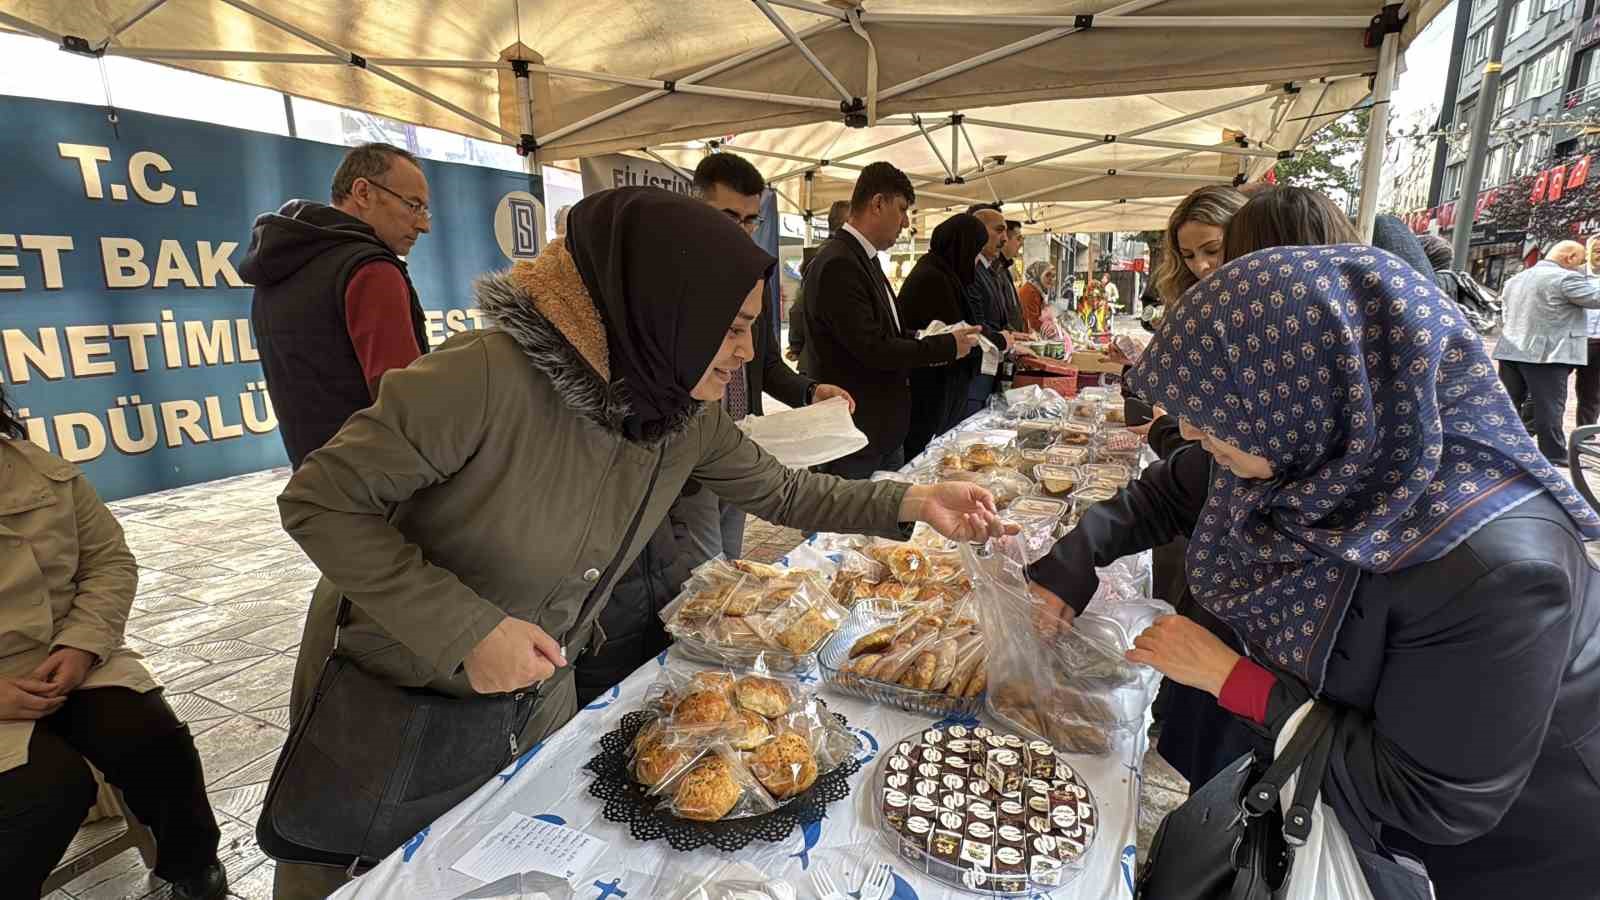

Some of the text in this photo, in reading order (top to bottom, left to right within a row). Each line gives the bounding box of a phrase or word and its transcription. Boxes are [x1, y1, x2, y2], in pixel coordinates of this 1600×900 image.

[58, 142, 198, 206] T.C.
[101, 236, 256, 289] BAK
[0, 309, 261, 384] NETİML
